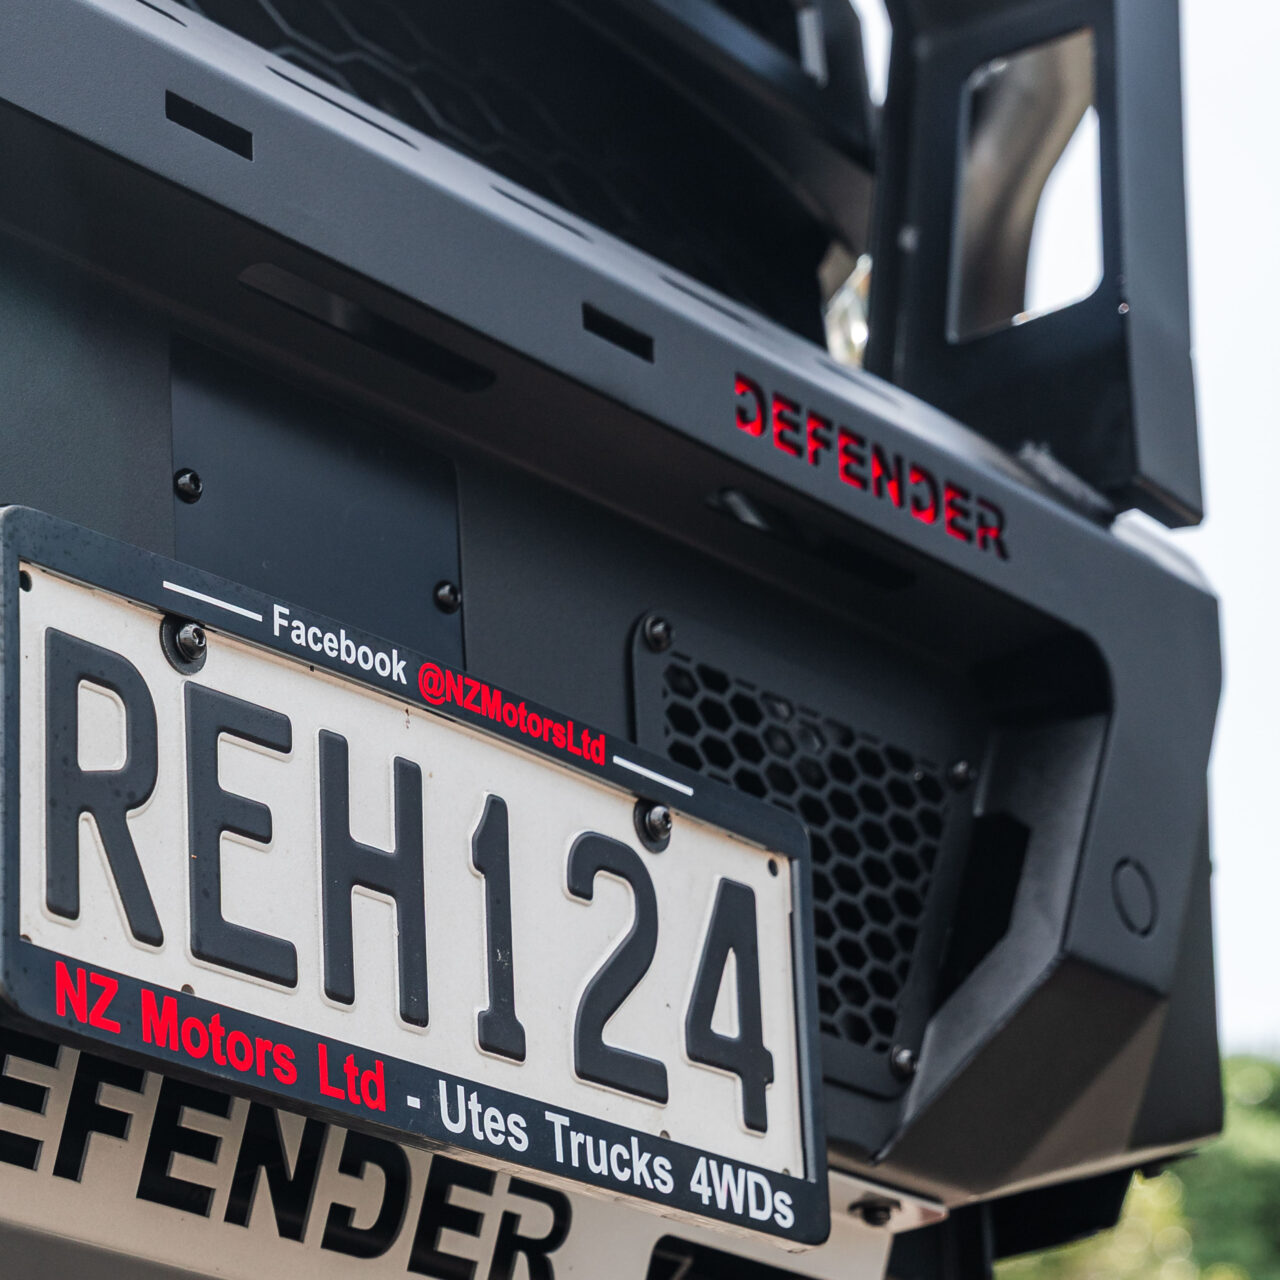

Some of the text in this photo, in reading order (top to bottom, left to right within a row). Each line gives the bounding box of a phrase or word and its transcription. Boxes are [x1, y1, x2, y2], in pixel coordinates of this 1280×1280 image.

[734, 372, 1010, 562] DEFENDER
[273, 604, 606, 766] Facebook @NZMotorsLtd
[44, 626, 776, 1134] REH124
[55, 960, 121, 1034] NZ
[141, 988, 298, 1085] Motors
[318, 1043, 387, 1113] Ltd
[438, 1079, 529, 1152] Utes
[544, 1110, 674, 1194] Trucks
[690, 1155, 795, 1229] 4WDs
